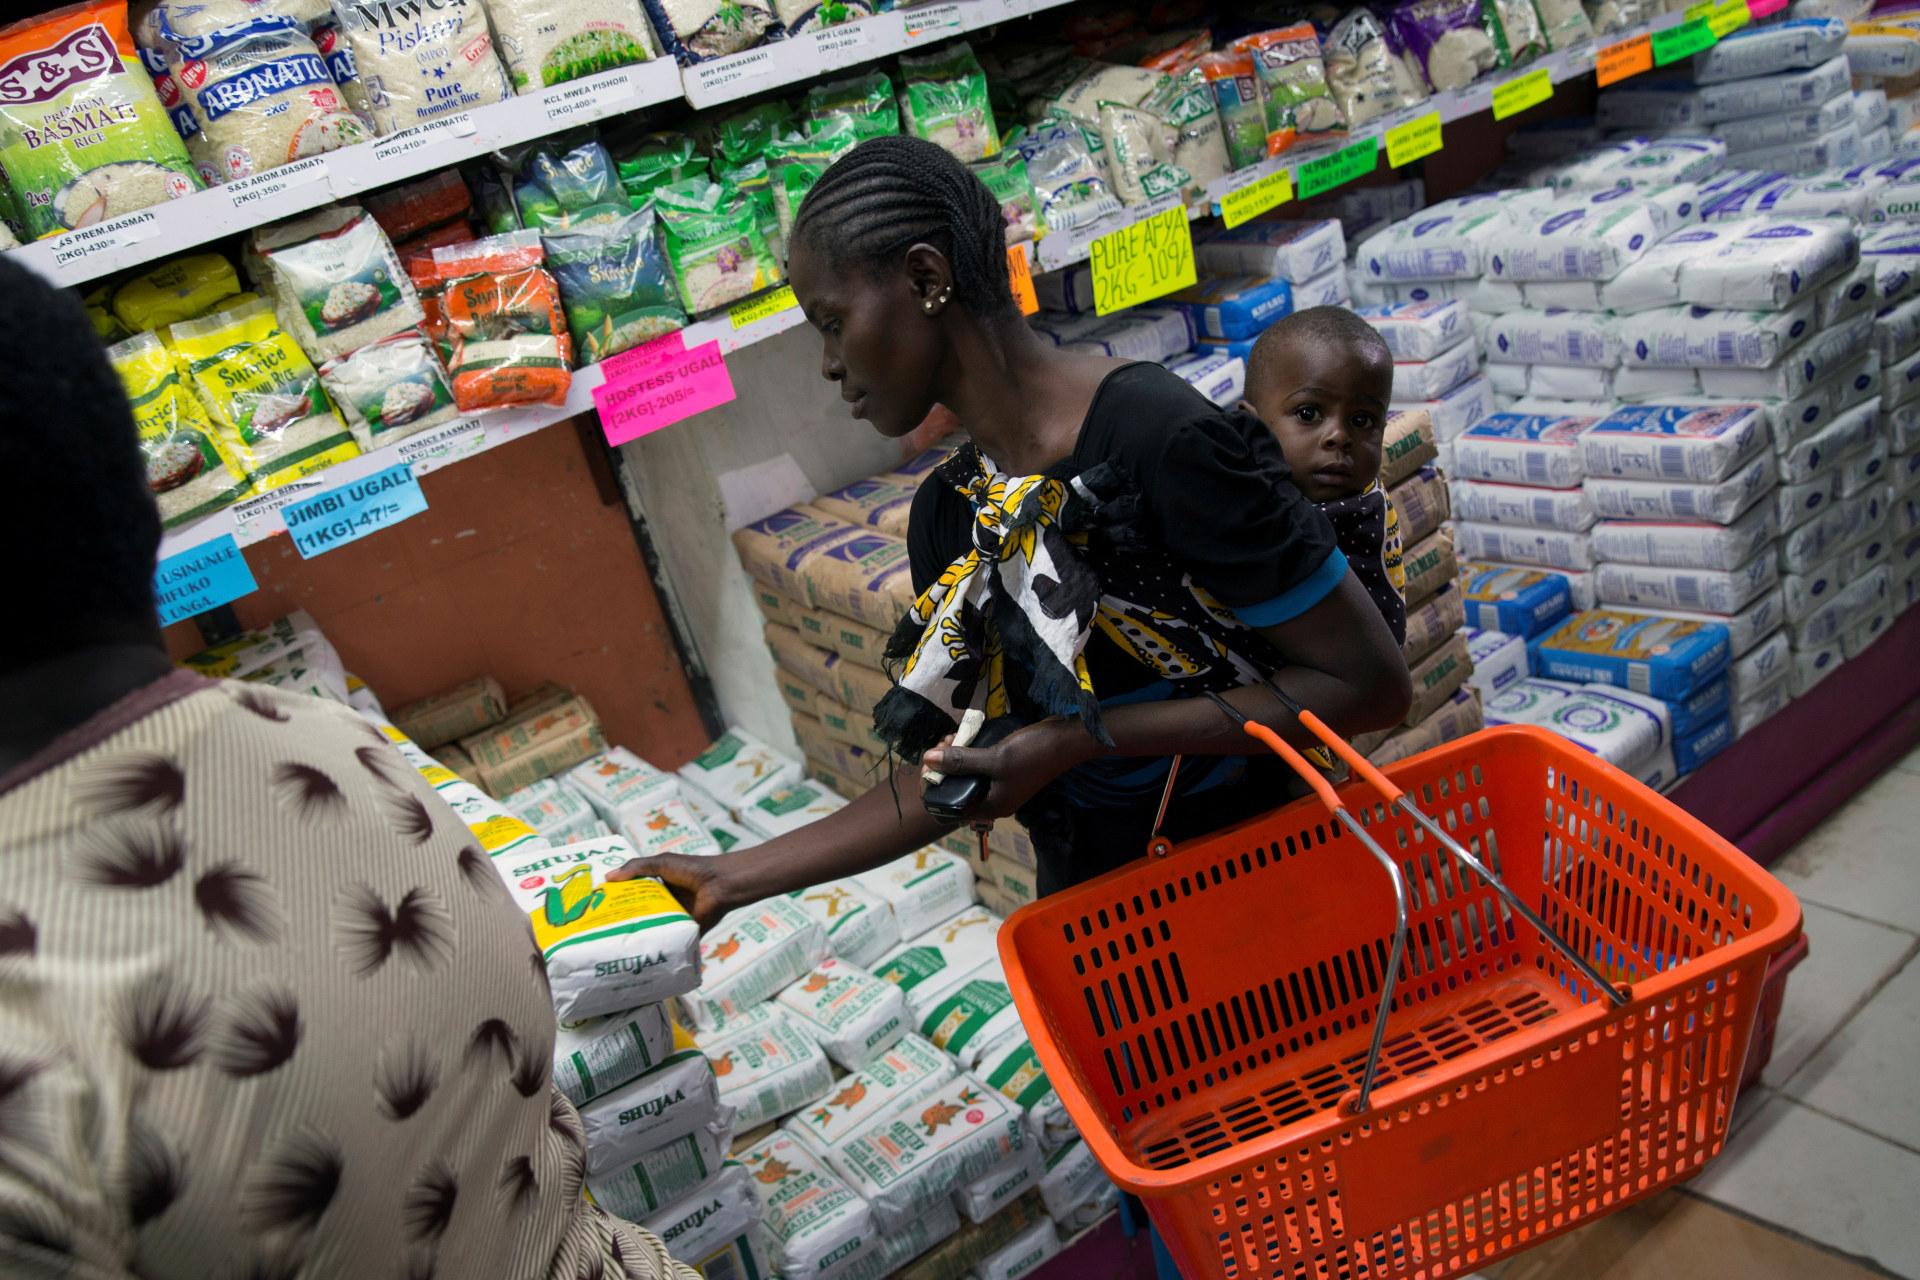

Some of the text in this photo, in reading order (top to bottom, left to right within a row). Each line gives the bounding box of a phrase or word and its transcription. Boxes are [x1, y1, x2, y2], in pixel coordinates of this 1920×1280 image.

[183, 61, 205, 86] NEW
[205, 57, 328, 116] AROMATIC
[700, 68, 716, 78] MPS
[416, 91, 480, 118] Aromatic Rice
[425, 81, 463, 102] Pure
[543, 75, 629, 106] KCL MWEA PISHORI
[43, 97, 107, 124] PREMIUM
[422, 113, 470, 133] AROMATIC
[547, 98, 597, 119] [2KG]-400/=
[73, 131, 107, 149] RICE
[375, 138, 427, 161] [2KG]-410/=
[1344, 141, 1375, 159] NGANO
[227, 180, 249, 193] S&S
[233, 182, 288, 207] [2KG]-350/=
[1258, 172, 1290, 190] NGANO
[52, 212, 156, 251] &S PREM.BASMATI
[1091, 231, 1137, 275] PURE
[1142, 208, 1188, 252] AFYA
[56, 238, 117, 264] [2KG]-430/=
[588, 256, 645, 284] Sunrice
[463, 279, 528, 309] Sunrice
[603, 333, 680, 370] SUNRICE BUDGET
[219, 348, 287, 388] Sunrice
[270, 367, 298, 389] RICE
[604, 352, 724, 407] HOSTESS UGALI
[134, 398, 180, 433] nrice
[611, 386, 697, 429] [2KG]-205/=
[399, 419, 481, 455] SUNRICE BASMATI
[1385, 428, 1423, 464] PEMBE
[298, 458, 333, 476] Sunrice
[287, 467, 414, 528] JIMBI UGALI
[296, 502, 401, 555] [1KG]-47/=
[161, 545, 238, 585] USINUNUE
[1404, 548, 1442, 582] PEMBE
[1422, 653, 1458, 691] PEMBE
[512, 845, 626, 878] SHUJAA
[594, 950, 669, 978] SHUJAA
[618, 1088, 687, 1127] SHUJAA
[662, 1199, 724, 1244] SHUJAA
